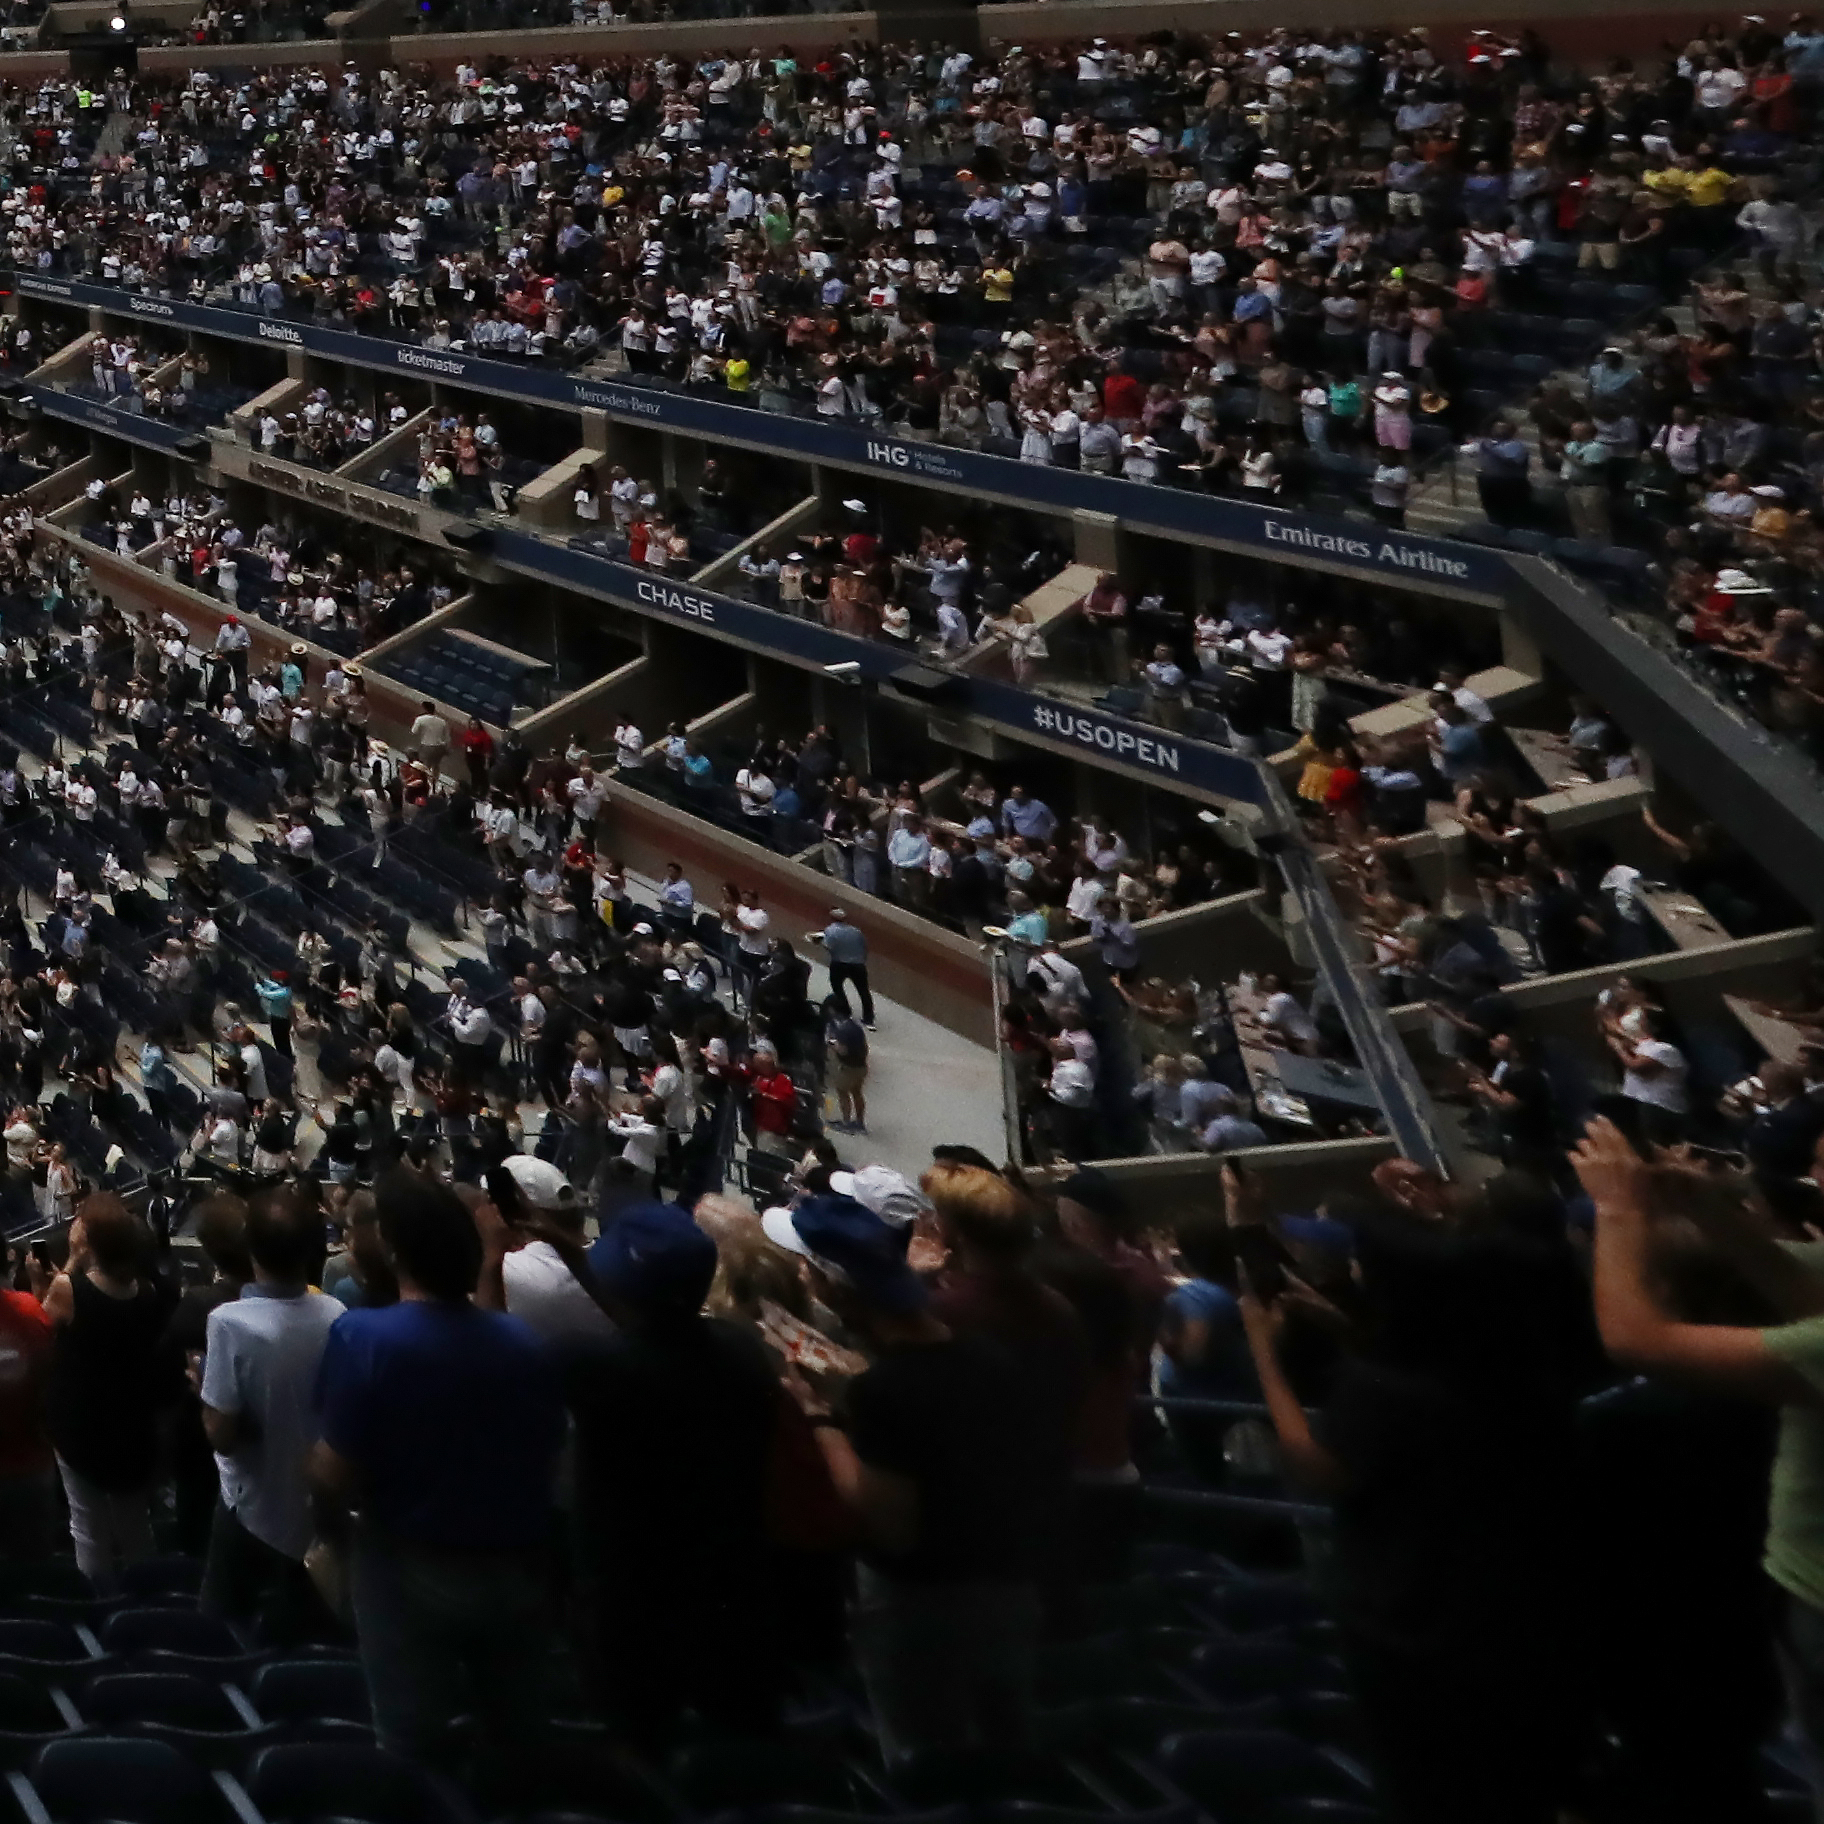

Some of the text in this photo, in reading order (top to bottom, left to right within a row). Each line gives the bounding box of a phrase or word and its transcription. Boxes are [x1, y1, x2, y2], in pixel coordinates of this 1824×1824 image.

[129, 296, 171, 316] Spectrum
[396, 349, 466, 376] ticketmaster
[574, 384, 661, 416] Mercedes-Benz
[867, 440, 910, 467] IHG
[1263, 519, 1470, 579] Emirates Airline
[636, 580, 716, 623] CHASE
[1033, 704, 1180, 773] #USOPEN
